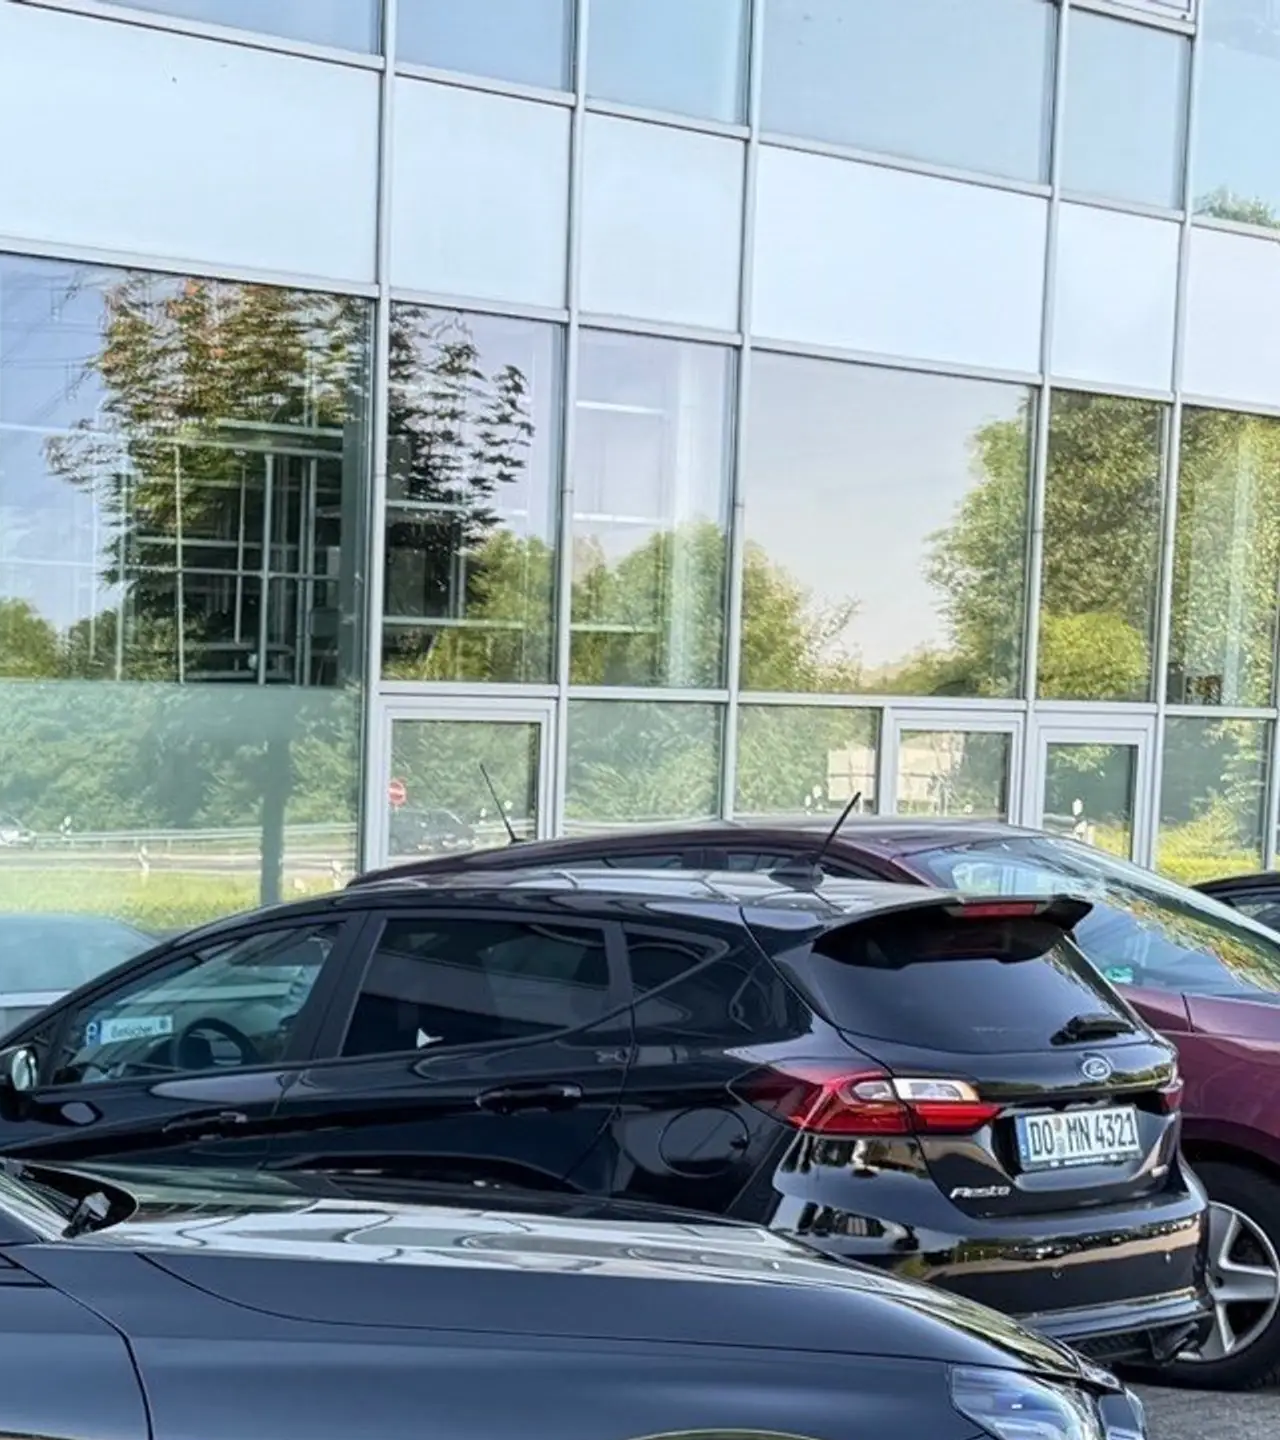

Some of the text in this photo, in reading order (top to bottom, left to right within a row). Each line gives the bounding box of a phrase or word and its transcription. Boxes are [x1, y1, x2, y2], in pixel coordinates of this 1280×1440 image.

[1029, 1112, 1137, 1156] DO MN 4321
